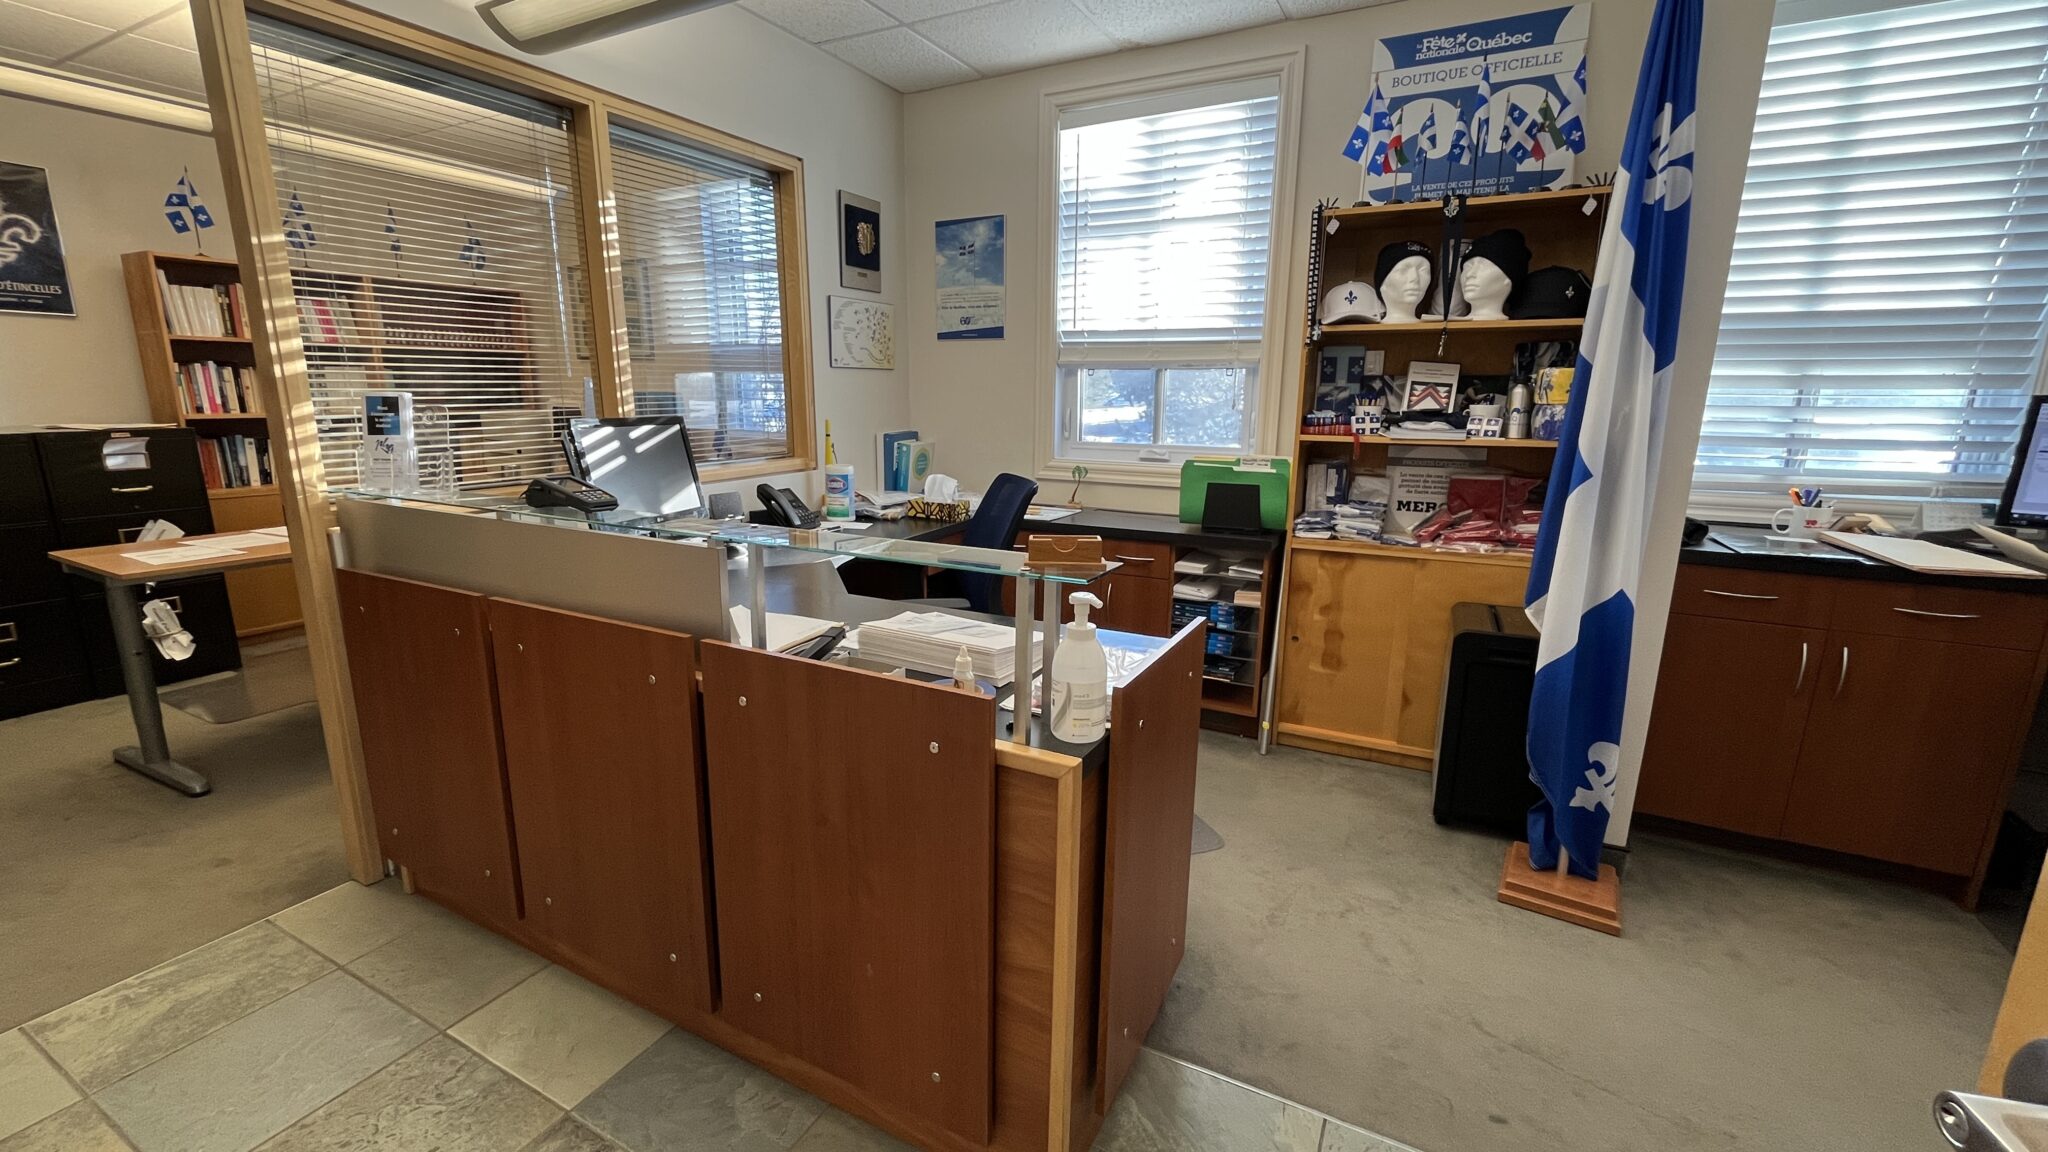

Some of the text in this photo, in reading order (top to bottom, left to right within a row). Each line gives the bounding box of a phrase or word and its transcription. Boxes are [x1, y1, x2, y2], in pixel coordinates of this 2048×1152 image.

[1422, 35, 1456, 53] Fête
[1466, 32, 1533, 52] Québec
[1415, 44, 1466, 61] nationale
[1391, 66, 1468, 89] BOUTIQUE
[1422, 182, 1447, 191] VENTE
